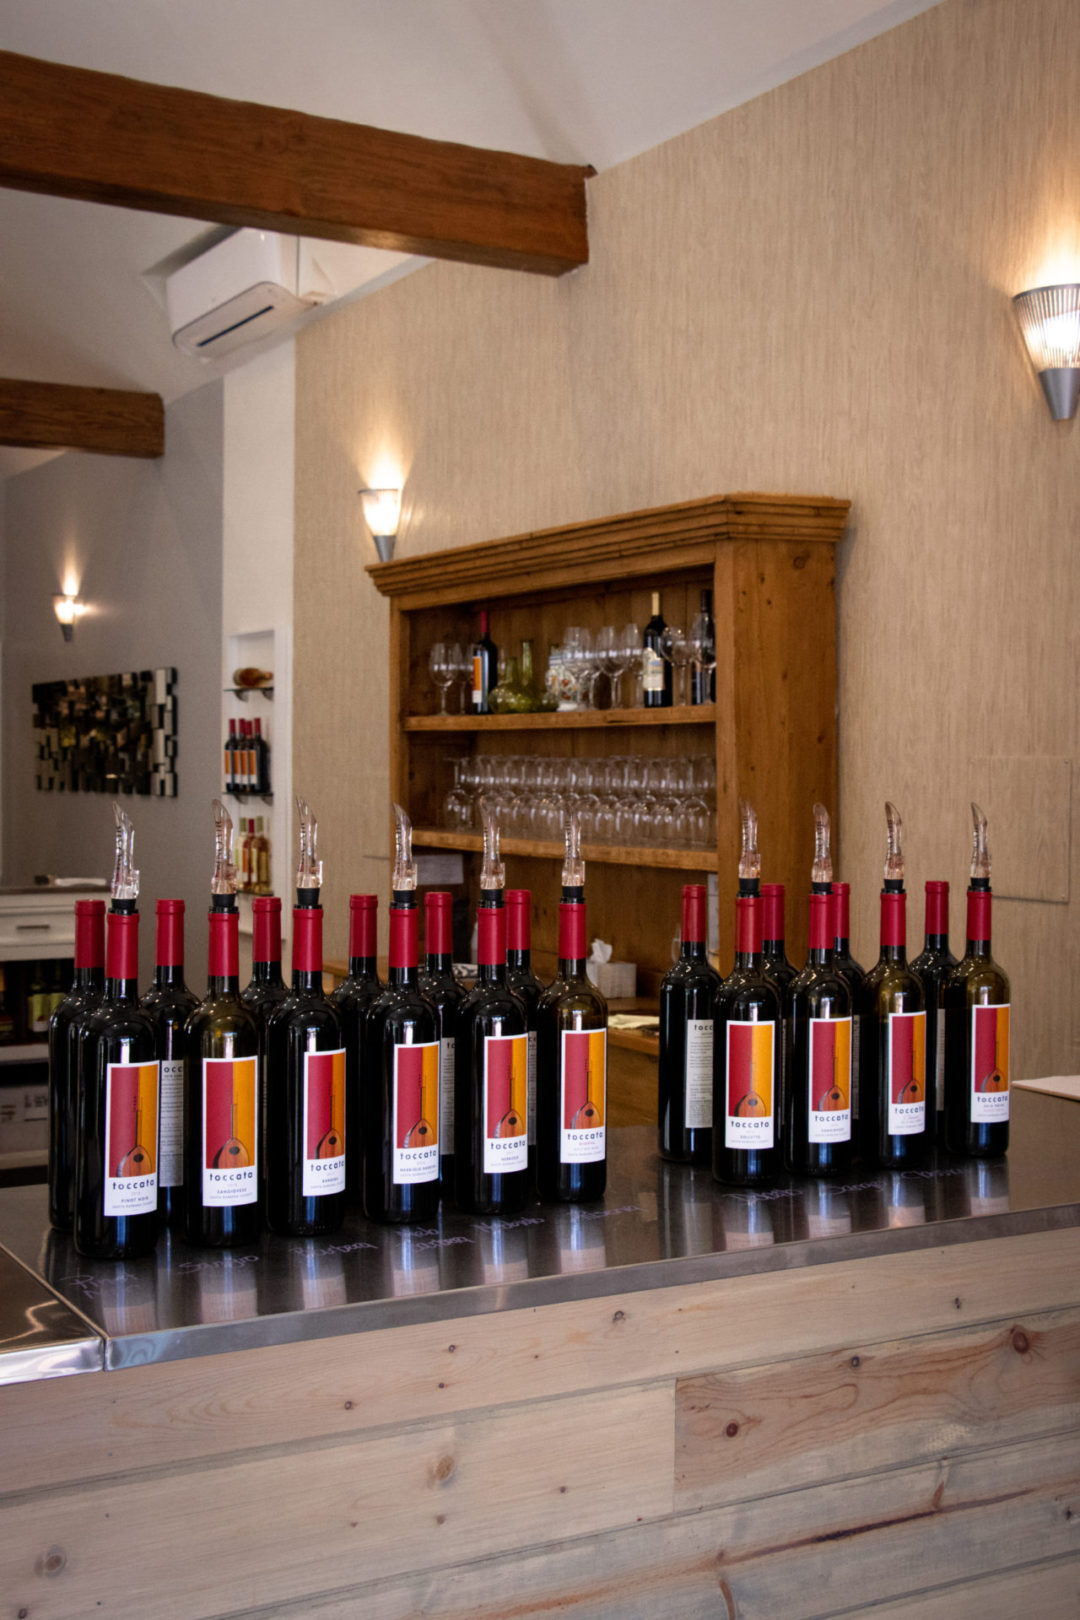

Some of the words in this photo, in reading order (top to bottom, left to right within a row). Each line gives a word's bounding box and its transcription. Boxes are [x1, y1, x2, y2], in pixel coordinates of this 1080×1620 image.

[815, 1114, 849, 1123] toccata
[731, 1120, 770, 1129] toccata
[567, 1131, 604, 1141] toccata
[490, 1140, 526, 1150] toccata
[400, 1149, 437, 1160] toccata
[310, 1160, 345, 1172] toccata
[209, 1172, 253, 1182] toccata
[112, 1179, 155, 1190] toccata
